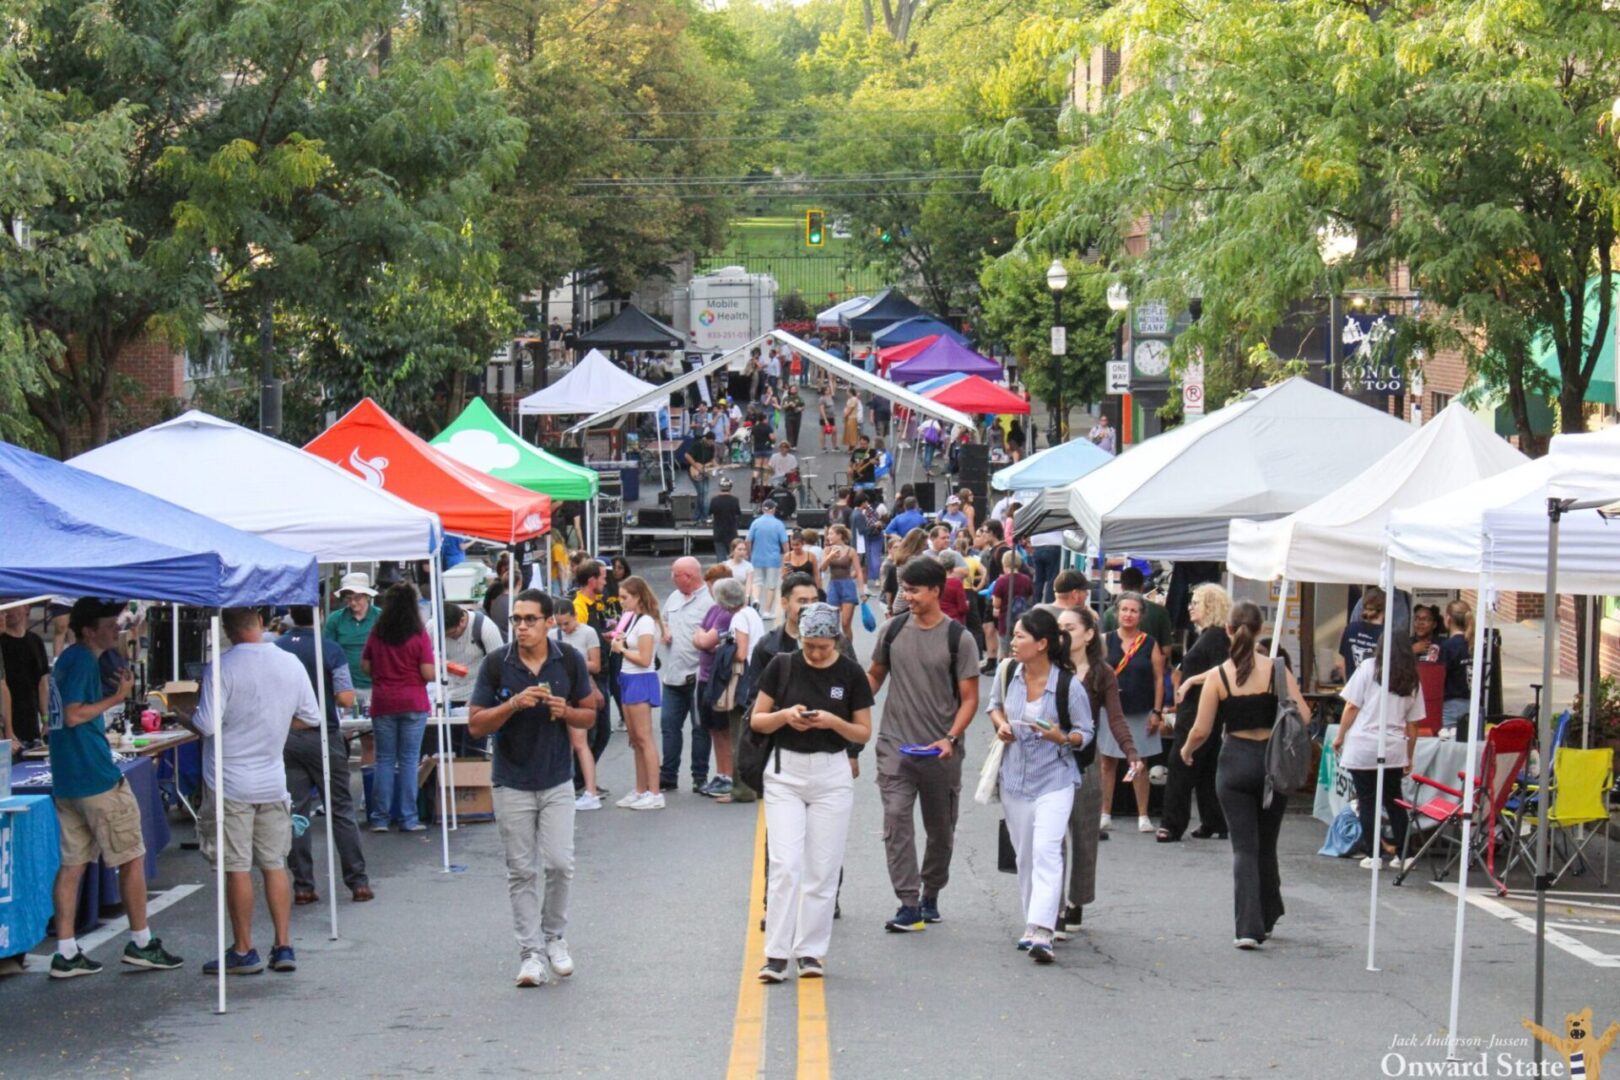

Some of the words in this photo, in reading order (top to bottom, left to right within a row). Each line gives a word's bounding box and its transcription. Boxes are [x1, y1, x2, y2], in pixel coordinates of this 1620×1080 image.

[707, 300, 739, 308] Mobile
[717, 312, 749, 320] Health
[1140, 322, 1166, 332] BANK
[1112, 364, 1127, 372] ONE
[1341, 364, 1401, 379] KONIC
